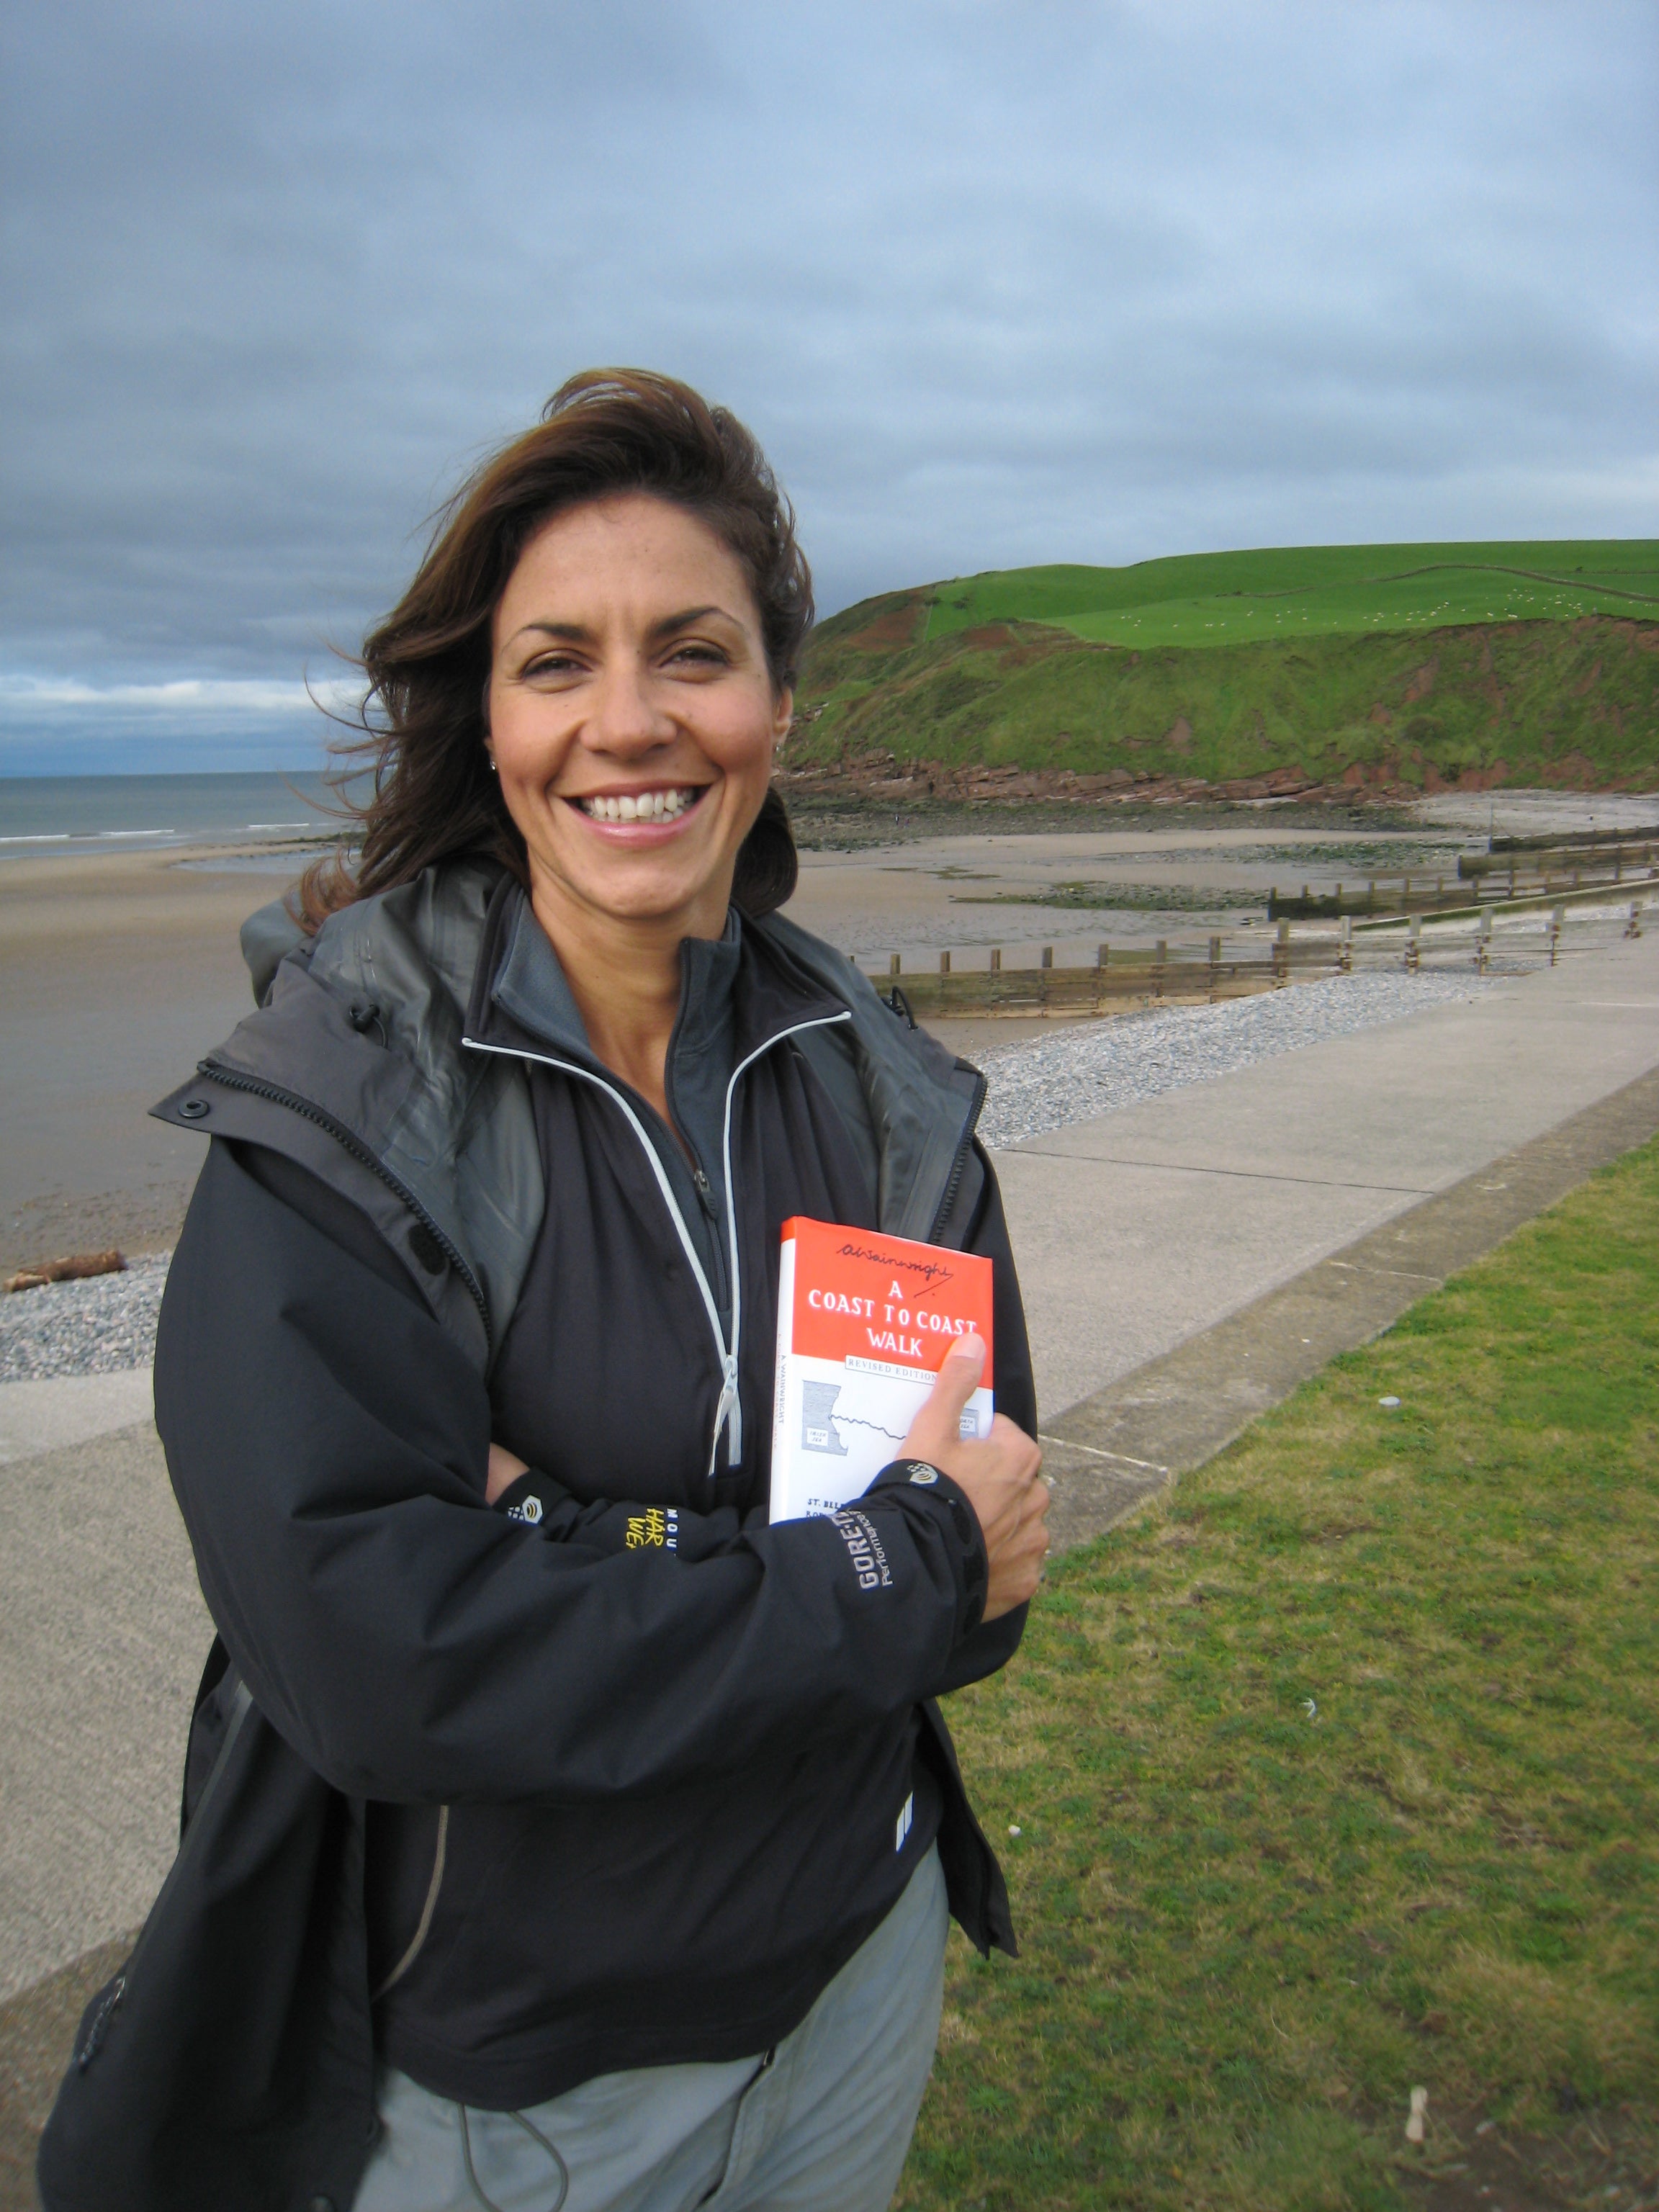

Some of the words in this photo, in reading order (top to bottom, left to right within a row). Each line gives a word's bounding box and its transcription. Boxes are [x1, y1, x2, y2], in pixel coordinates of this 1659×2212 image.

[889, 1280, 903, 1298] A
[808, 1289, 875, 1318] COAST
[884, 1304, 910, 1326] TO
[917, 1310, 977, 1335] COAST
[866, 1328, 923, 1357] WALK
[848, 1358, 891, 1374] REVISED
[896, 1367, 939, 1382] EDITION
[626, 1517, 646, 1549] WE
[645, 1508, 665, 1546] HAR
[666, 1508, 678, 1555] MOU
[832, 1511, 879, 1589] GORE-T
[857, 1514, 893, 1586] Performance
